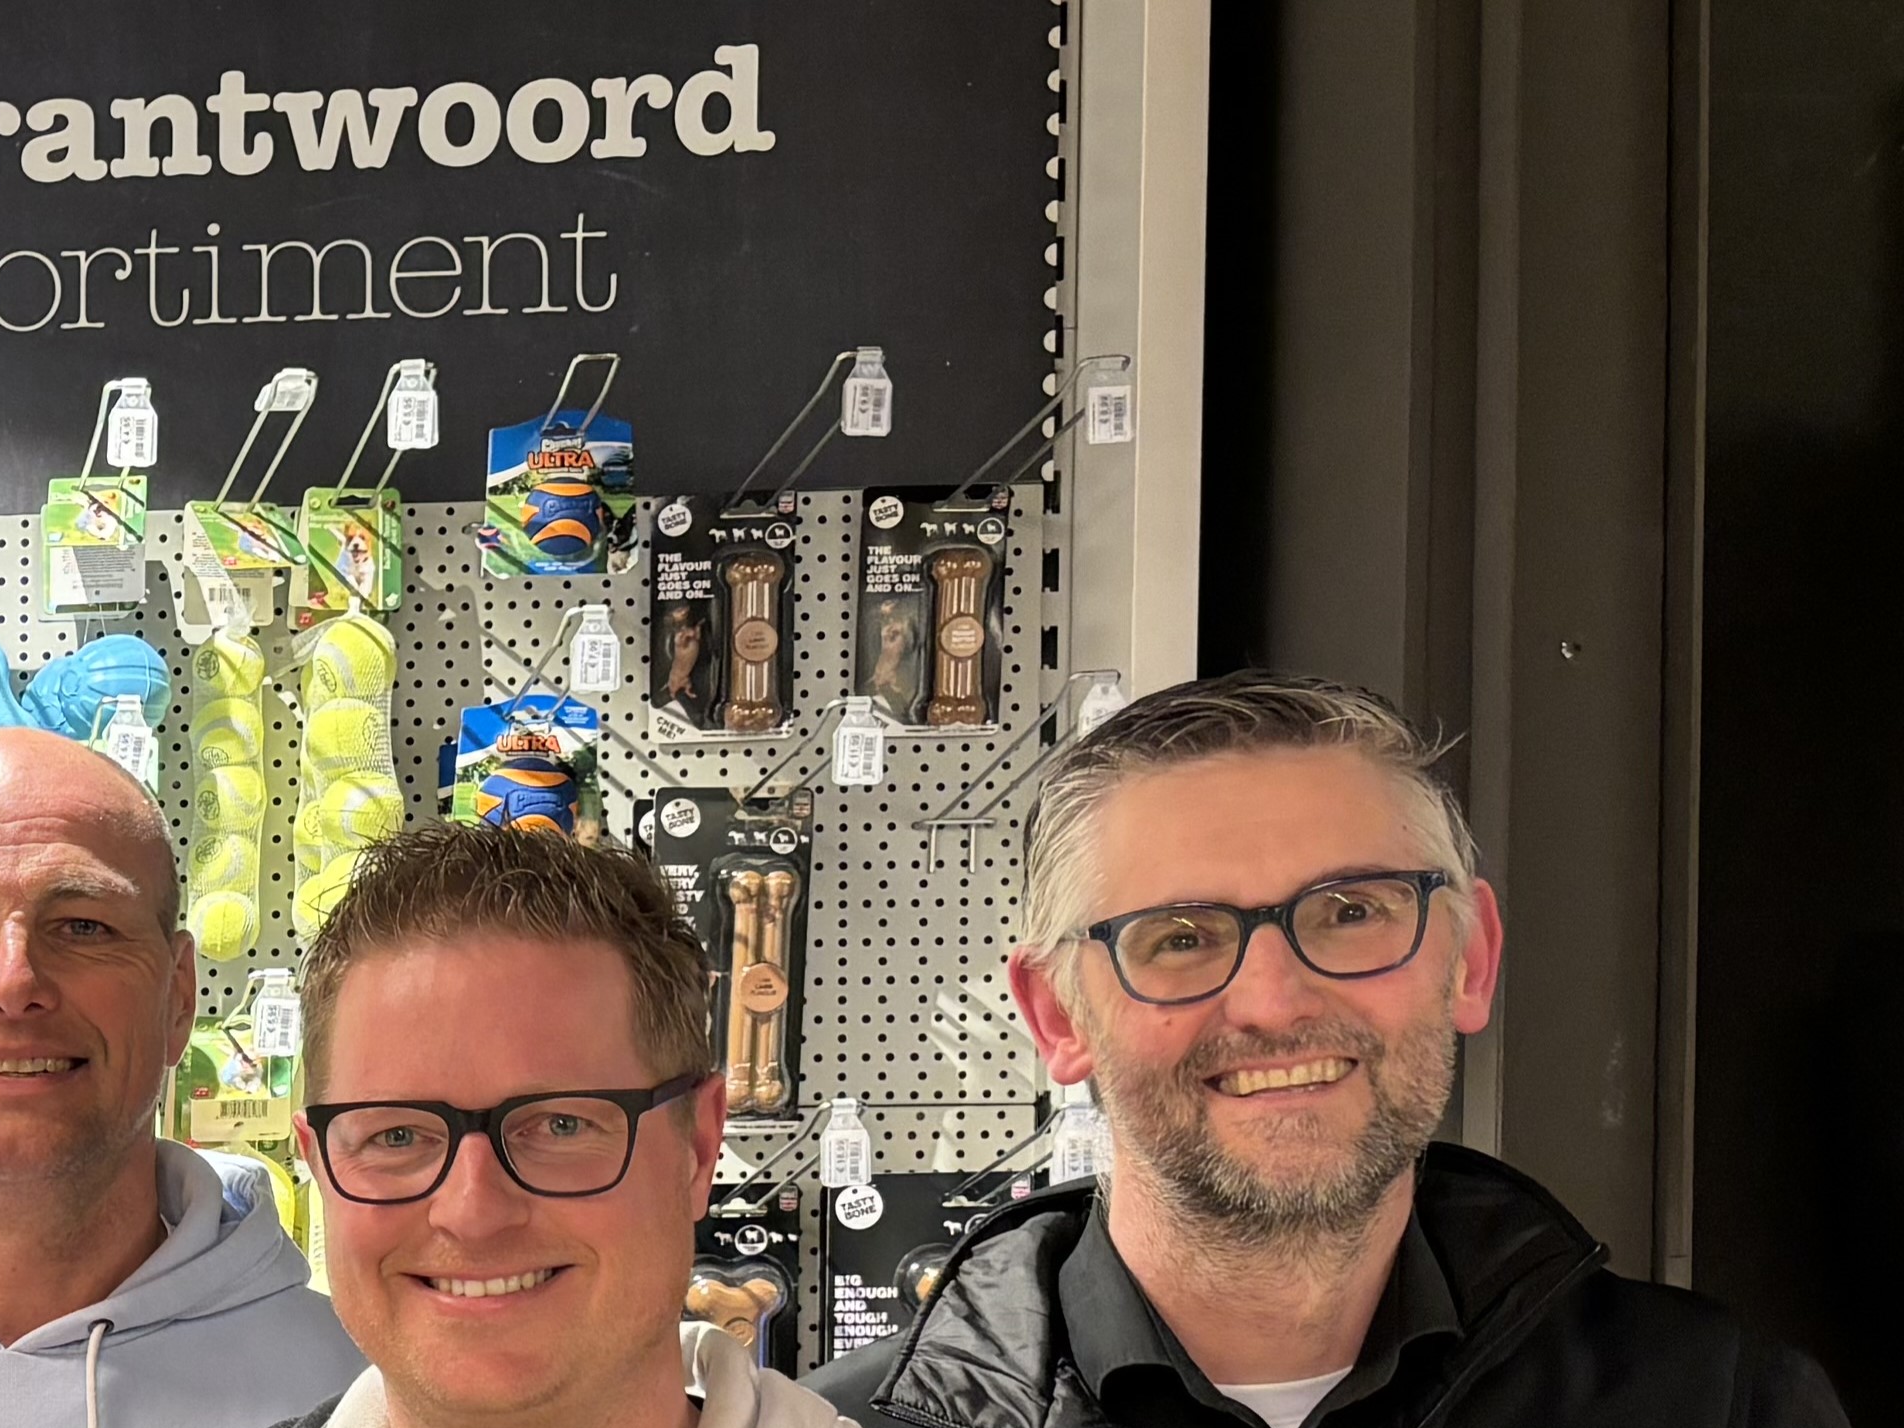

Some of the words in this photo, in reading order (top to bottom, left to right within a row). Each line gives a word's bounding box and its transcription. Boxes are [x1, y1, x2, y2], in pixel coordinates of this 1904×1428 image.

[527, 451, 595, 469] ULTRA
[873, 503, 898, 515] TASTY
[867, 546, 892, 555] THE
[658, 552, 682, 562] THE
[867, 555, 922, 565] FLAVOUR
[657, 560, 712, 572] FLAVOUR
[866, 565, 897, 574] JUST
[657, 572, 688, 582] JUST
[866, 574, 900, 584] GOES
[902, 574, 920, 583] ON
[657, 581, 690, 591] GOES
[693, 580, 711, 589] ON
[866, 583, 892, 593] AND
[657, 590, 683, 600] AND
[656, 716, 686, 735] CHEW
[496, 735, 561, 753] ULTRA
[665, 807, 694, 820] TASTY
[668, 816, 695, 829] BONE
[840, 1195, 875, 1211] TASTY
[844, 1204, 877, 1220] BONE
[834, 1274, 863, 1286] BIG
[834, 1286, 898, 1299] ENOUGH
[834, 1300, 867, 1312] AND
[834, 1312, 888, 1324] TOUGH
[834, 1324, 898, 1337] ENOUGH
